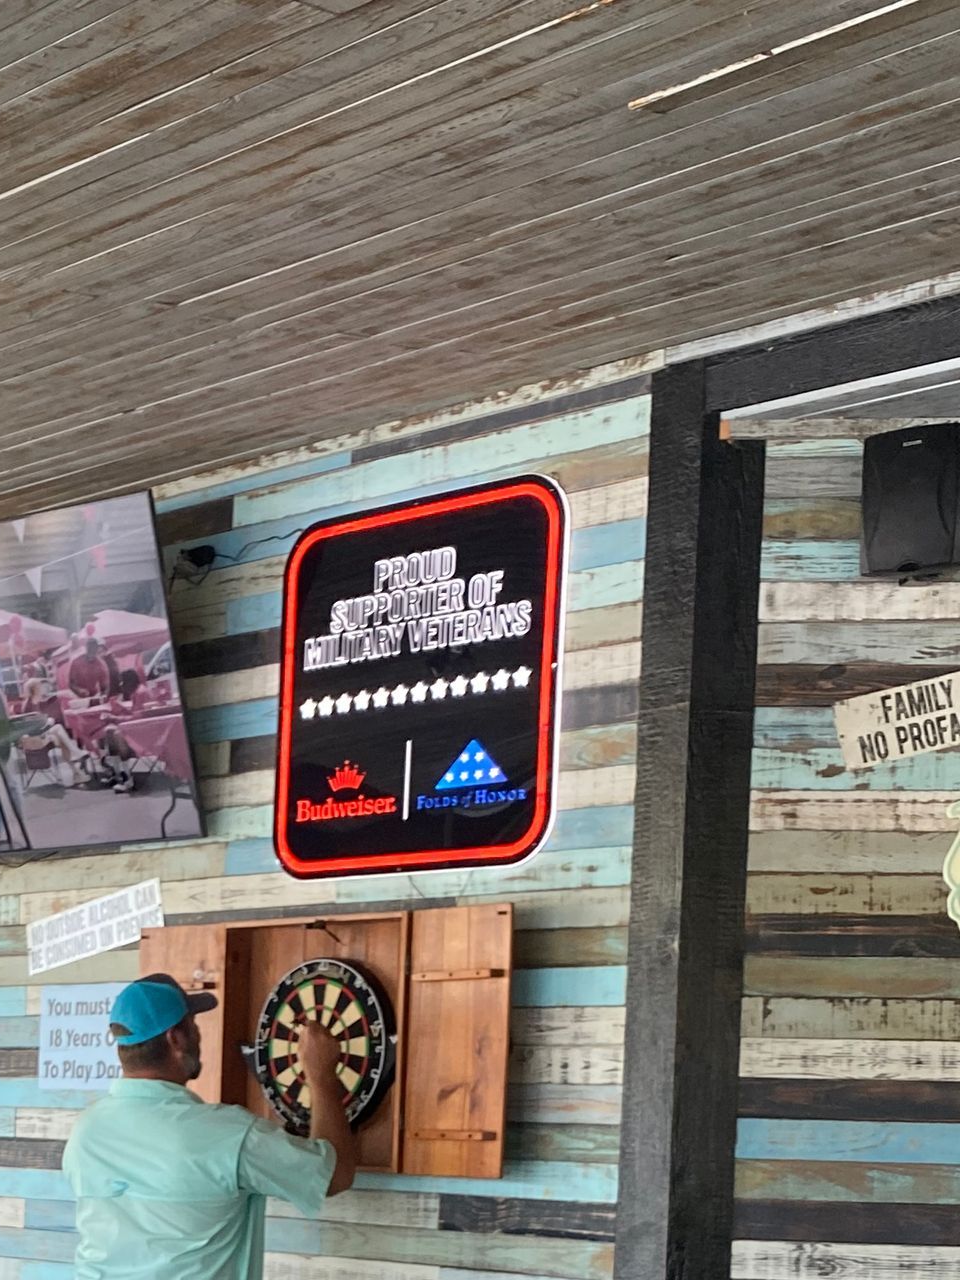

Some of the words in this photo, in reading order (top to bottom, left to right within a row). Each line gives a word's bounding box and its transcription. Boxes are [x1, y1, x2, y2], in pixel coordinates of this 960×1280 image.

[373, 546, 457, 593] PROUD
[329, 578, 466, 634] SUPPORTER
[468, 570, 504, 608] OF
[302, 622, 406, 671] MILITARY
[407, 600, 533, 652] VETERANS
[880, 678, 953, 724] FAMILY
[857, 730, 889, 763] NO
[894, 712, 960, 754] PROFA
[416, 794, 458, 811] FOLDS
[474, 788, 527, 804] HONOR
[47, 998, 72, 1016] You
[74, 997, 111, 1016] must
[49, 1028, 63, 1047] 18
[66, 1028, 102, 1047] Years
[105, 1028, 117, 1047] O
[43, 1060, 60, 1078] To
[62, 1059, 93, 1083] Play
[96, 1060, 122, 1079] Dar
